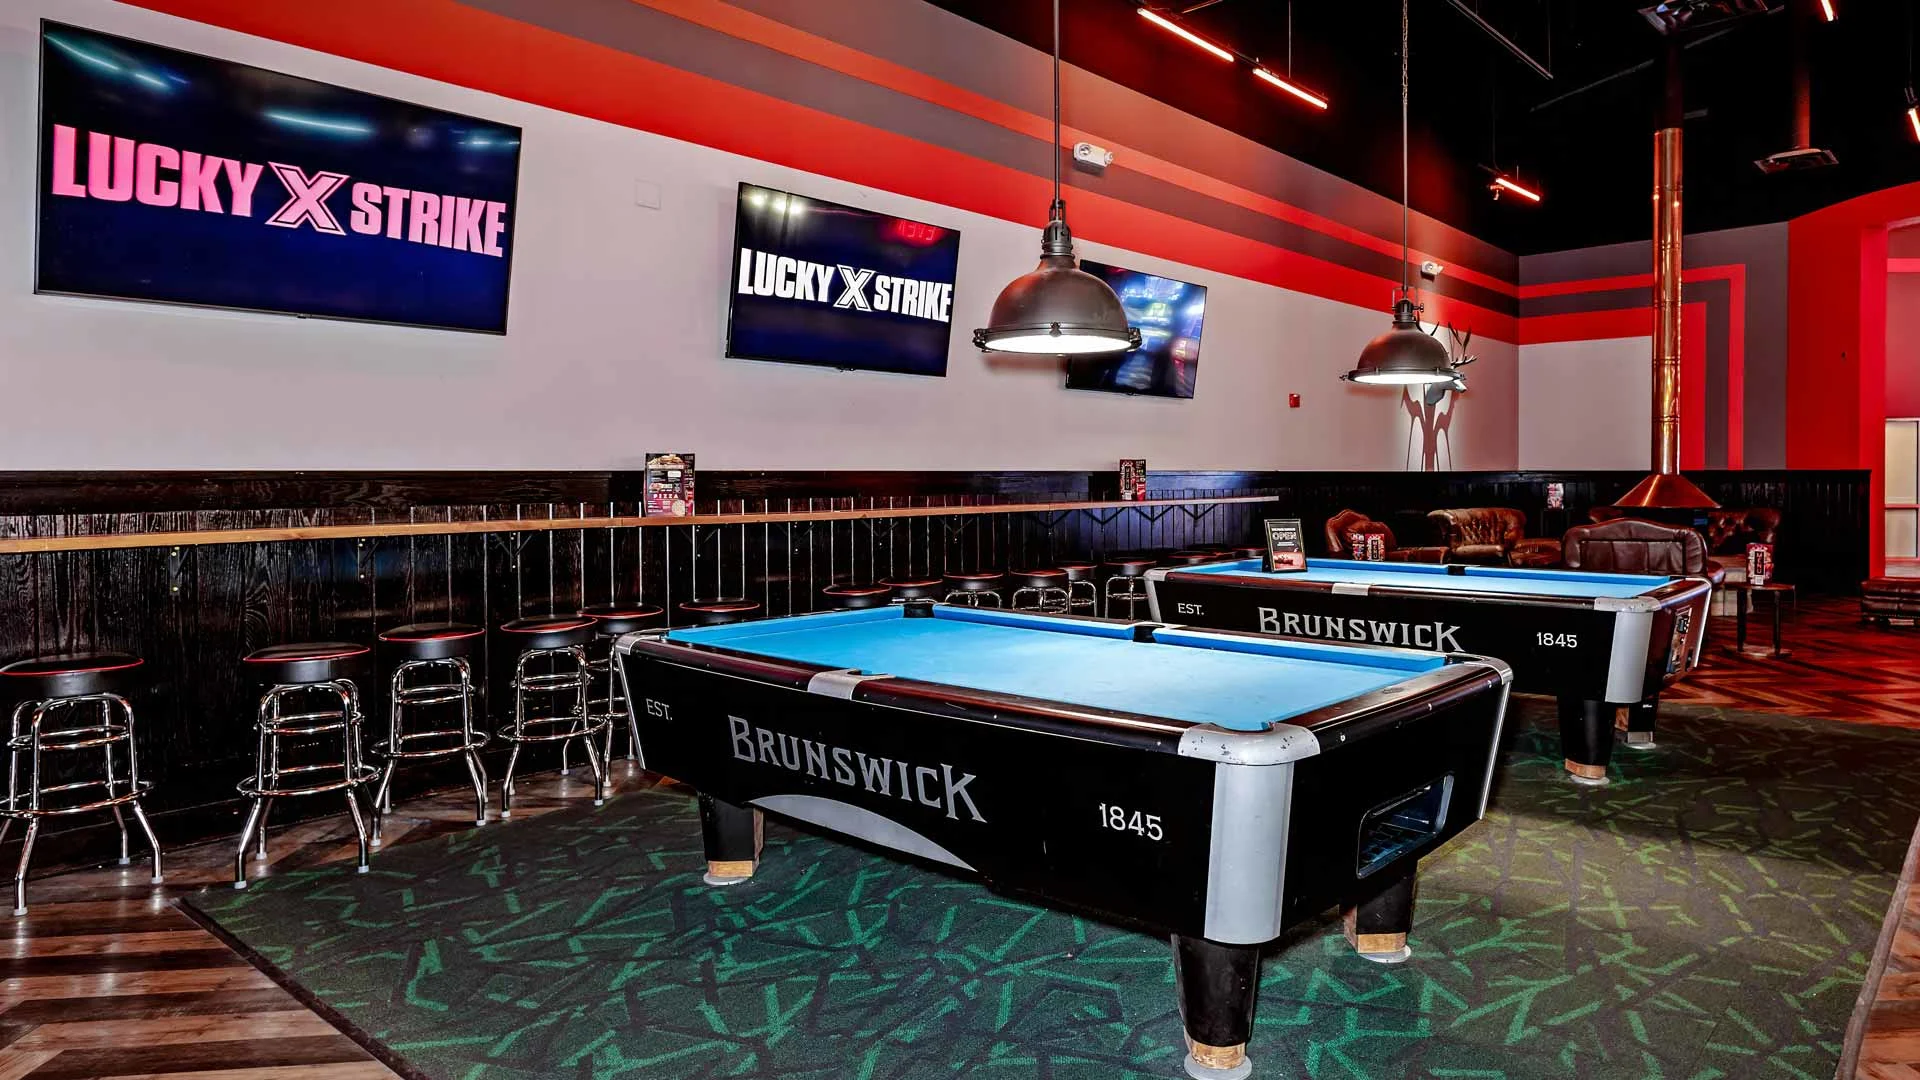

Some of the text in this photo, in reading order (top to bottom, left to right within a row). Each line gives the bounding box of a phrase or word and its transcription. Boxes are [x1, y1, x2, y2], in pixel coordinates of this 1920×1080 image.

[52, 124, 507, 258] LUCKY X STRIKE
[738, 248, 953, 323] LUCKY X STRIKE
[1272, 531, 1297, 540] OPEN
[1177, 603, 1578, 653] EST. BRUNSWICK 1845
[646, 698, 1163, 841] EST. BRUNSWICK 1845
